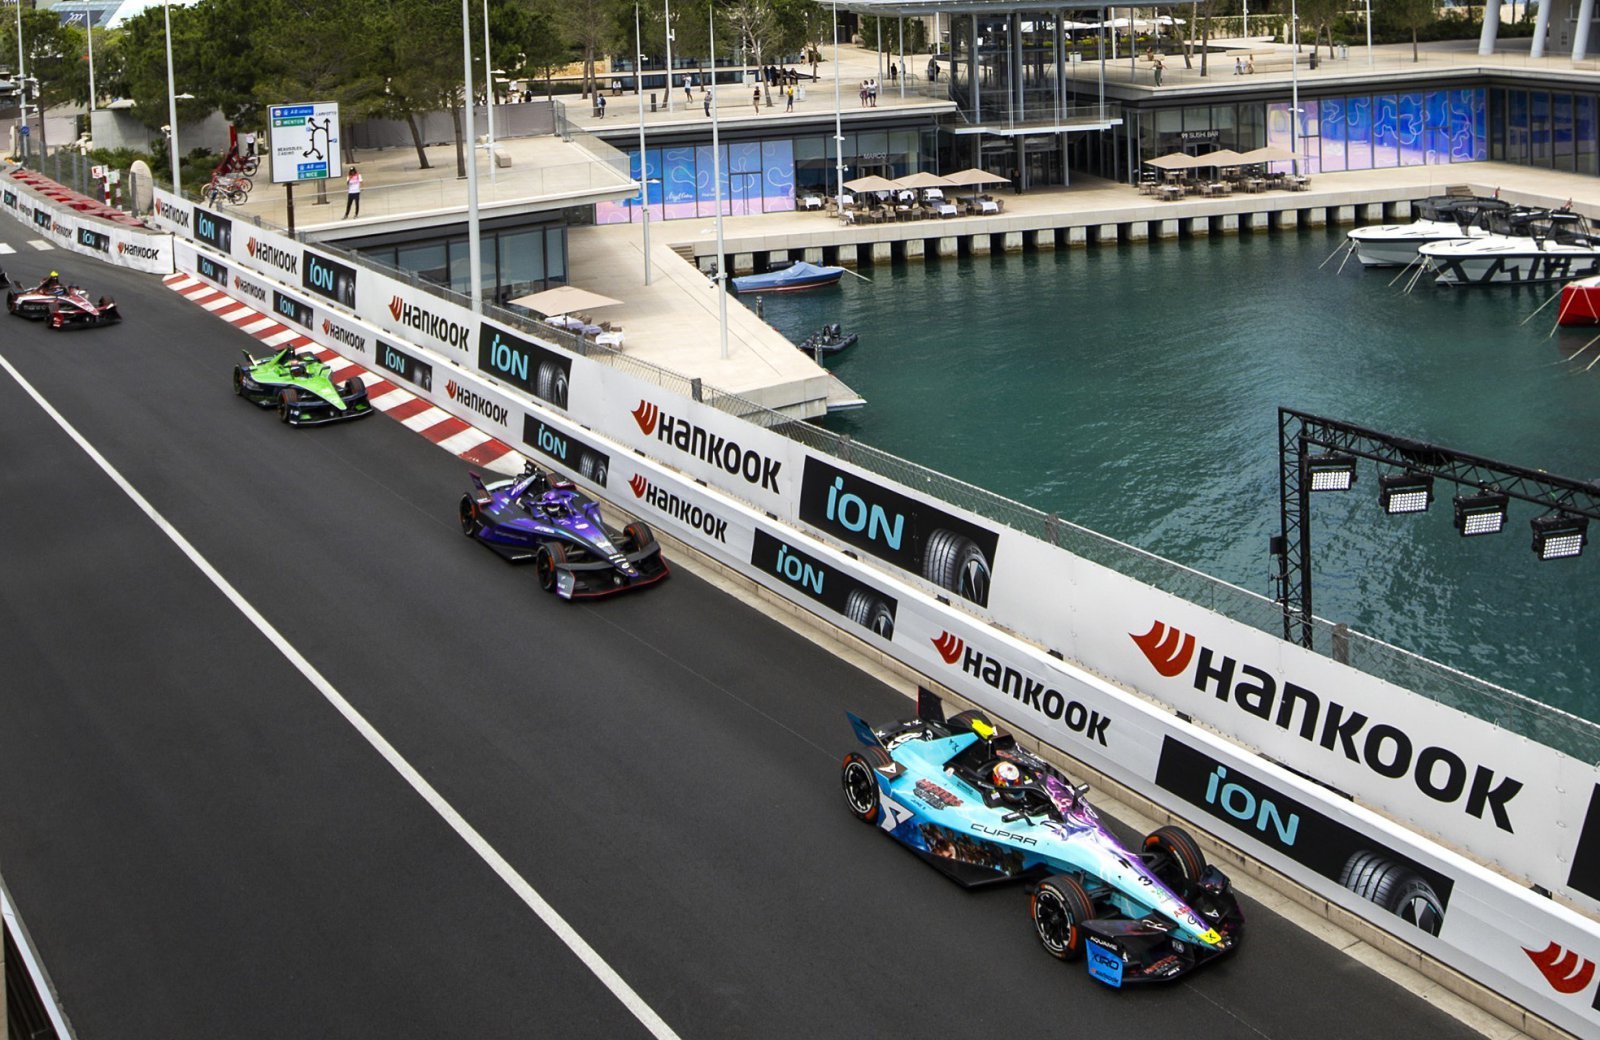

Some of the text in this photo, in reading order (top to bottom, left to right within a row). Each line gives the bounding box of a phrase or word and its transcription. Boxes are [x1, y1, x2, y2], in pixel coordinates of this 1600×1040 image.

[199, 213, 214, 240] iON
[310, 258, 333, 291] iON
[280, 296, 295, 317] iON
[385, 347, 404, 373] iON
[491, 335, 528, 381] iON
[538, 424, 567, 460] iON
[826, 476, 905, 551] iON
[776, 544, 824, 594] iON
[1204, 766, 1300, 847] iON
[970, 824, 1038, 846] CUPRA
